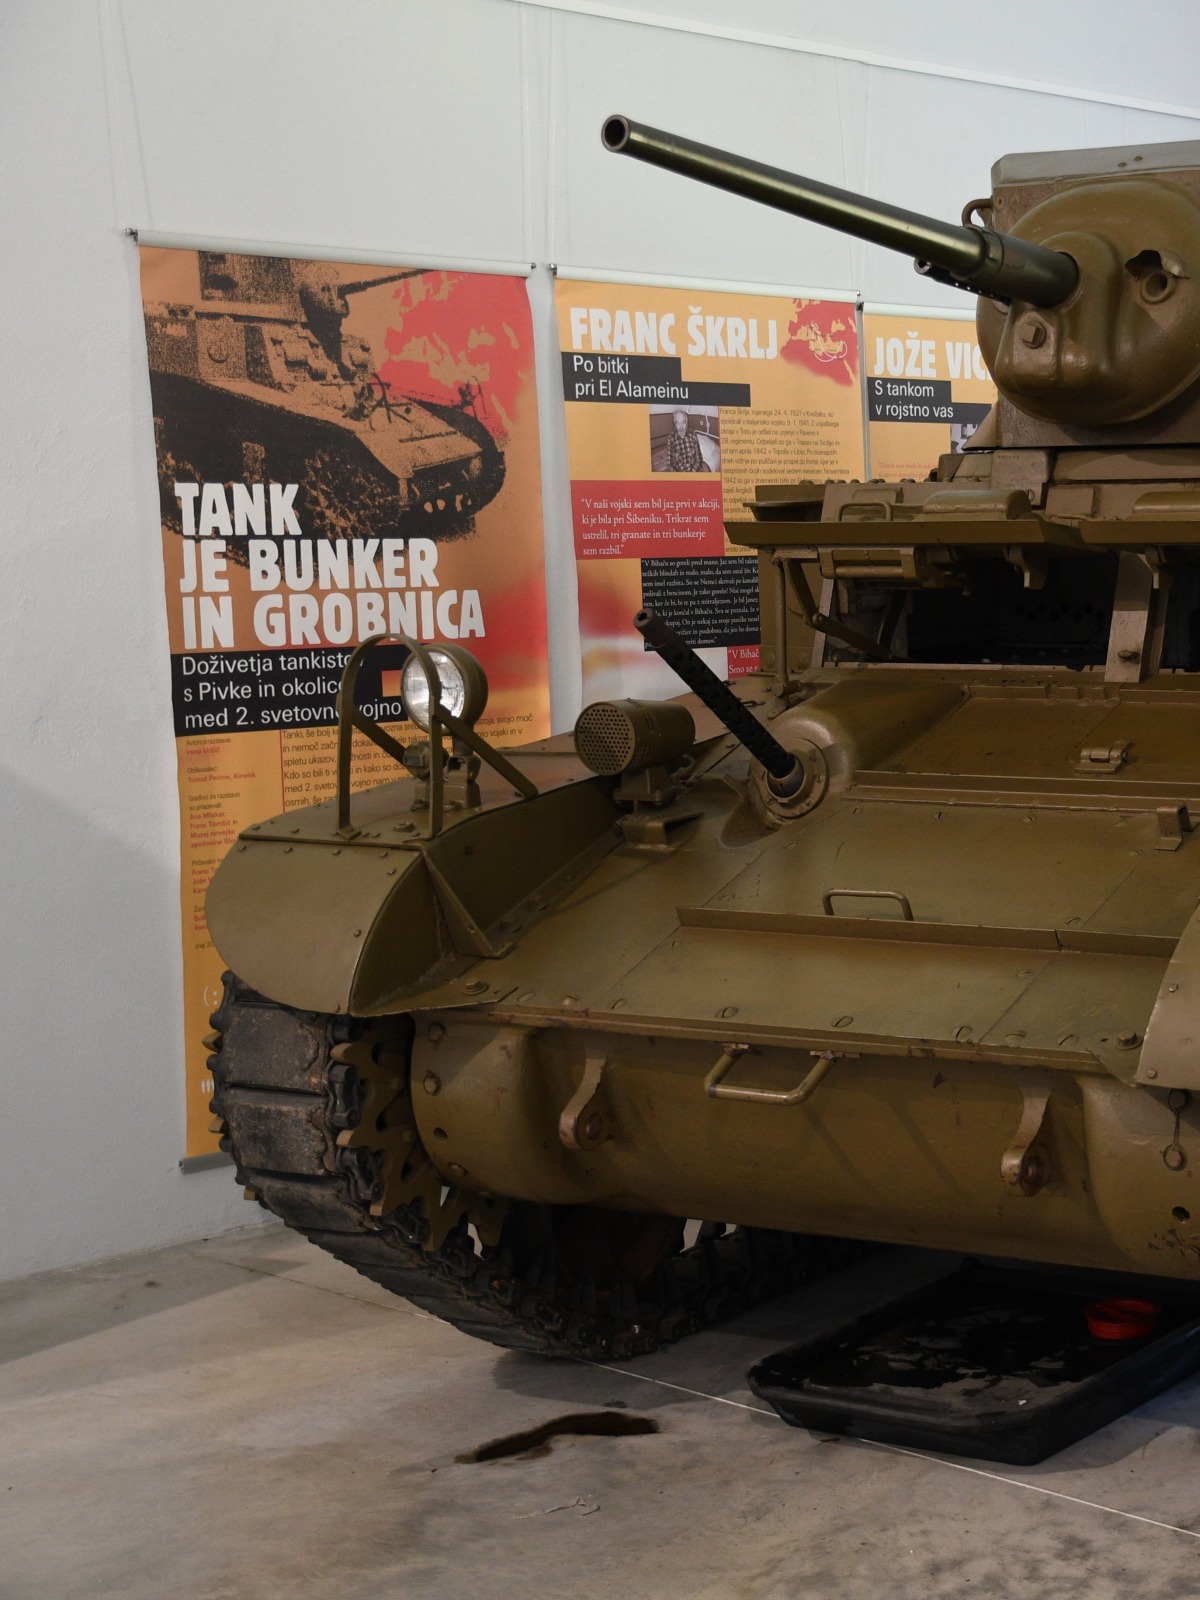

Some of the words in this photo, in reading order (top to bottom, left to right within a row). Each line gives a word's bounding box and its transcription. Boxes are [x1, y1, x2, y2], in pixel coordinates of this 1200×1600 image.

[570, 308, 676, 354] FRANC
[688, 306, 777, 359] ŠKRLJ
[573, 355, 593, 373] Po
[598, 357, 629, 374] bitki
[874, 331, 936, 377] JOŽE
[945, 342, 992, 380] VIC
[575, 380, 594, 398] pri
[600, 380, 611, 396] El
[616, 381, 688, 399] Alameinu
[875, 380, 883, 395] S
[887, 382, 934, 397] tankom
[876, 404, 882, 415] v
[886, 402, 929, 419] rojstno
[933, 406, 953, 418] vas
[175, 483, 302, 535] TANK
[594, 499, 608, 509] naši
[610, 499, 632, 512] vojski
[652, 499, 661, 508] bil
[663, 500, 674, 511] jaz
[676, 499, 690, 511] prvi
[582, 514, 589, 524] ki
[590, 515, 597, 527] je
[599, 514, 612, 524] bila
[614, 514, 624, 527] pri
[626, 512, 664, 524] Šibeniku.
[666, 513, 692, 523] Trikrat
[611, 530, 619, 539] tri
[622, 531, 651, 542] granate
[653, 529, 661, 538] in
[662, 529, 671, 538] tri
[673, 528, 705, 540] bunkerje
[180, 539, 229, 592] JE
[248, 538, 439, 591] BUNKER
[182, 596, 234, 649] IN
[254, 590, 485, 646] GROBNICA
[182, 654, 273, 676] Doživetja
[279, 650, 363, 671] tankisto
[184, 688, 192, 702] s
[199, 680, 252, 701] Pivke
[258, 680, 275, 698] in
[185, 708, 228, 728] med
[236, 707, 254, 725] 2.
[261, 706, 339, 724] svetovn
[517, 714, 533, 722] moč
[292, 742, 319, 752] nemoč
[284, 771, 300, 780] Kdo
[364, 764, 381, 772] kako
[285, 784, 303, 793] med
